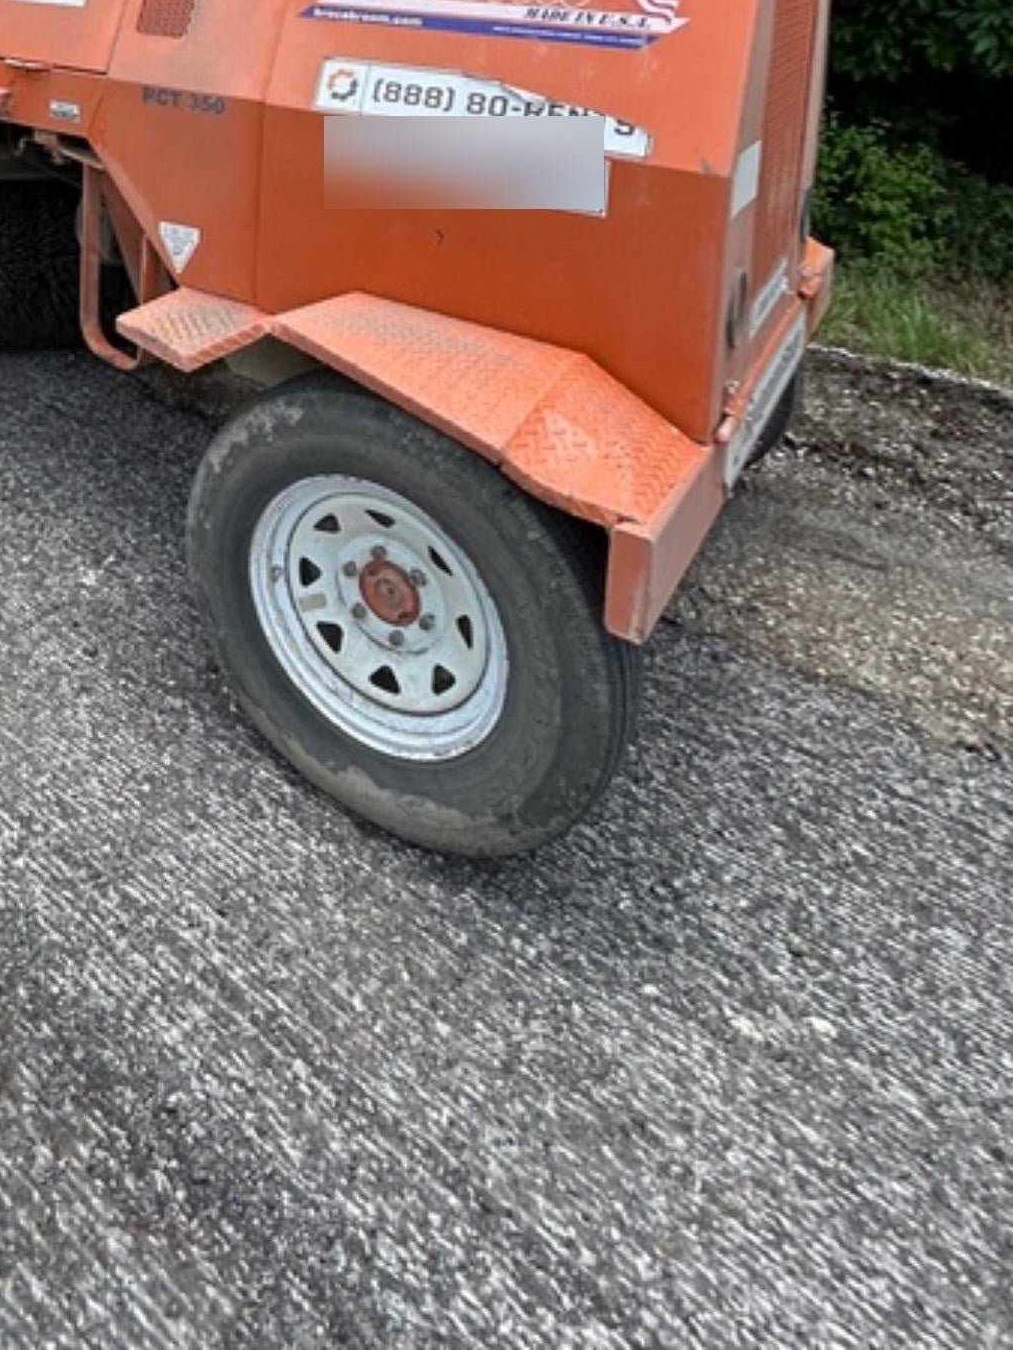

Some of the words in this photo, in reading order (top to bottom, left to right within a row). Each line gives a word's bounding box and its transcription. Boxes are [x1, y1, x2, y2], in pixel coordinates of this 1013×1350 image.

[525, 6, 570, 21] MADE
[575, 11, 594, 24] IN
[372, 77, 455, 112] (888)
